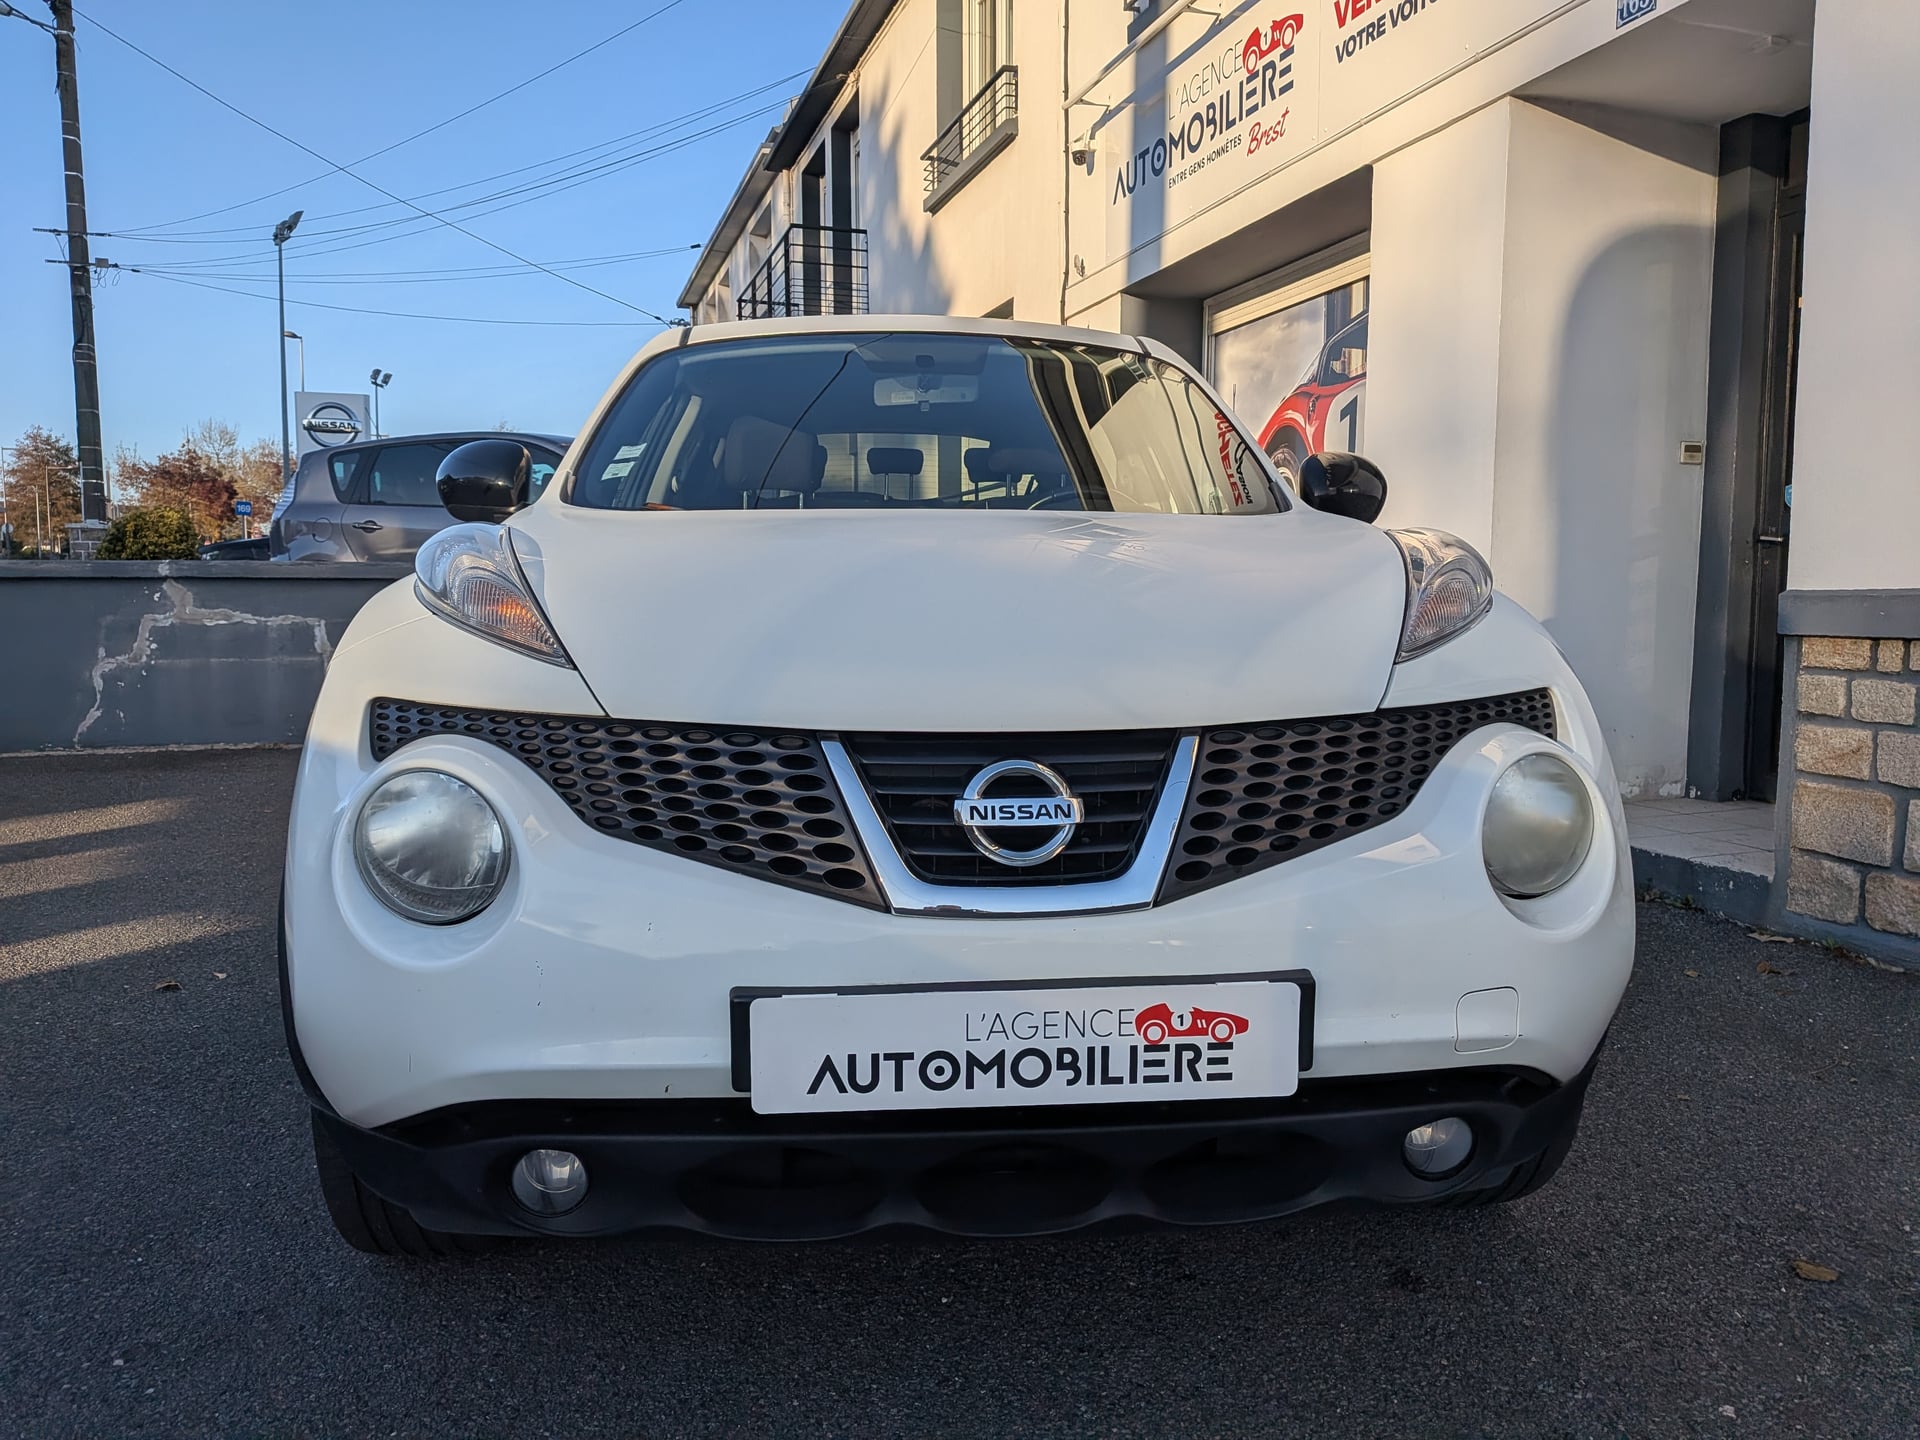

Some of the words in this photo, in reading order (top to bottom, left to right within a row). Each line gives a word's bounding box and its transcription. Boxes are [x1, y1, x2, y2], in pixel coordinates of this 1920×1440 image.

[1335, 13, 1386, 64] VOTRE
[1168, 39, 1244, 121] L'AGENCE
[1246, 106, 1290, 157] Brest
[1168, 168, 1188, 189] ENTRE
[1188, 157, 1206, 177] GENS
[1206, 133, 1242, 165] HONNÊTES
[307, 420, 356, 430] NISSAN
[1339, 394, 1359, 453] 1
[969, 803, 1072, 821] NISSAN
[965, 1008, 1136, 1042] L'AGENCE
[1177, 1013, 1185, 1027] 1
